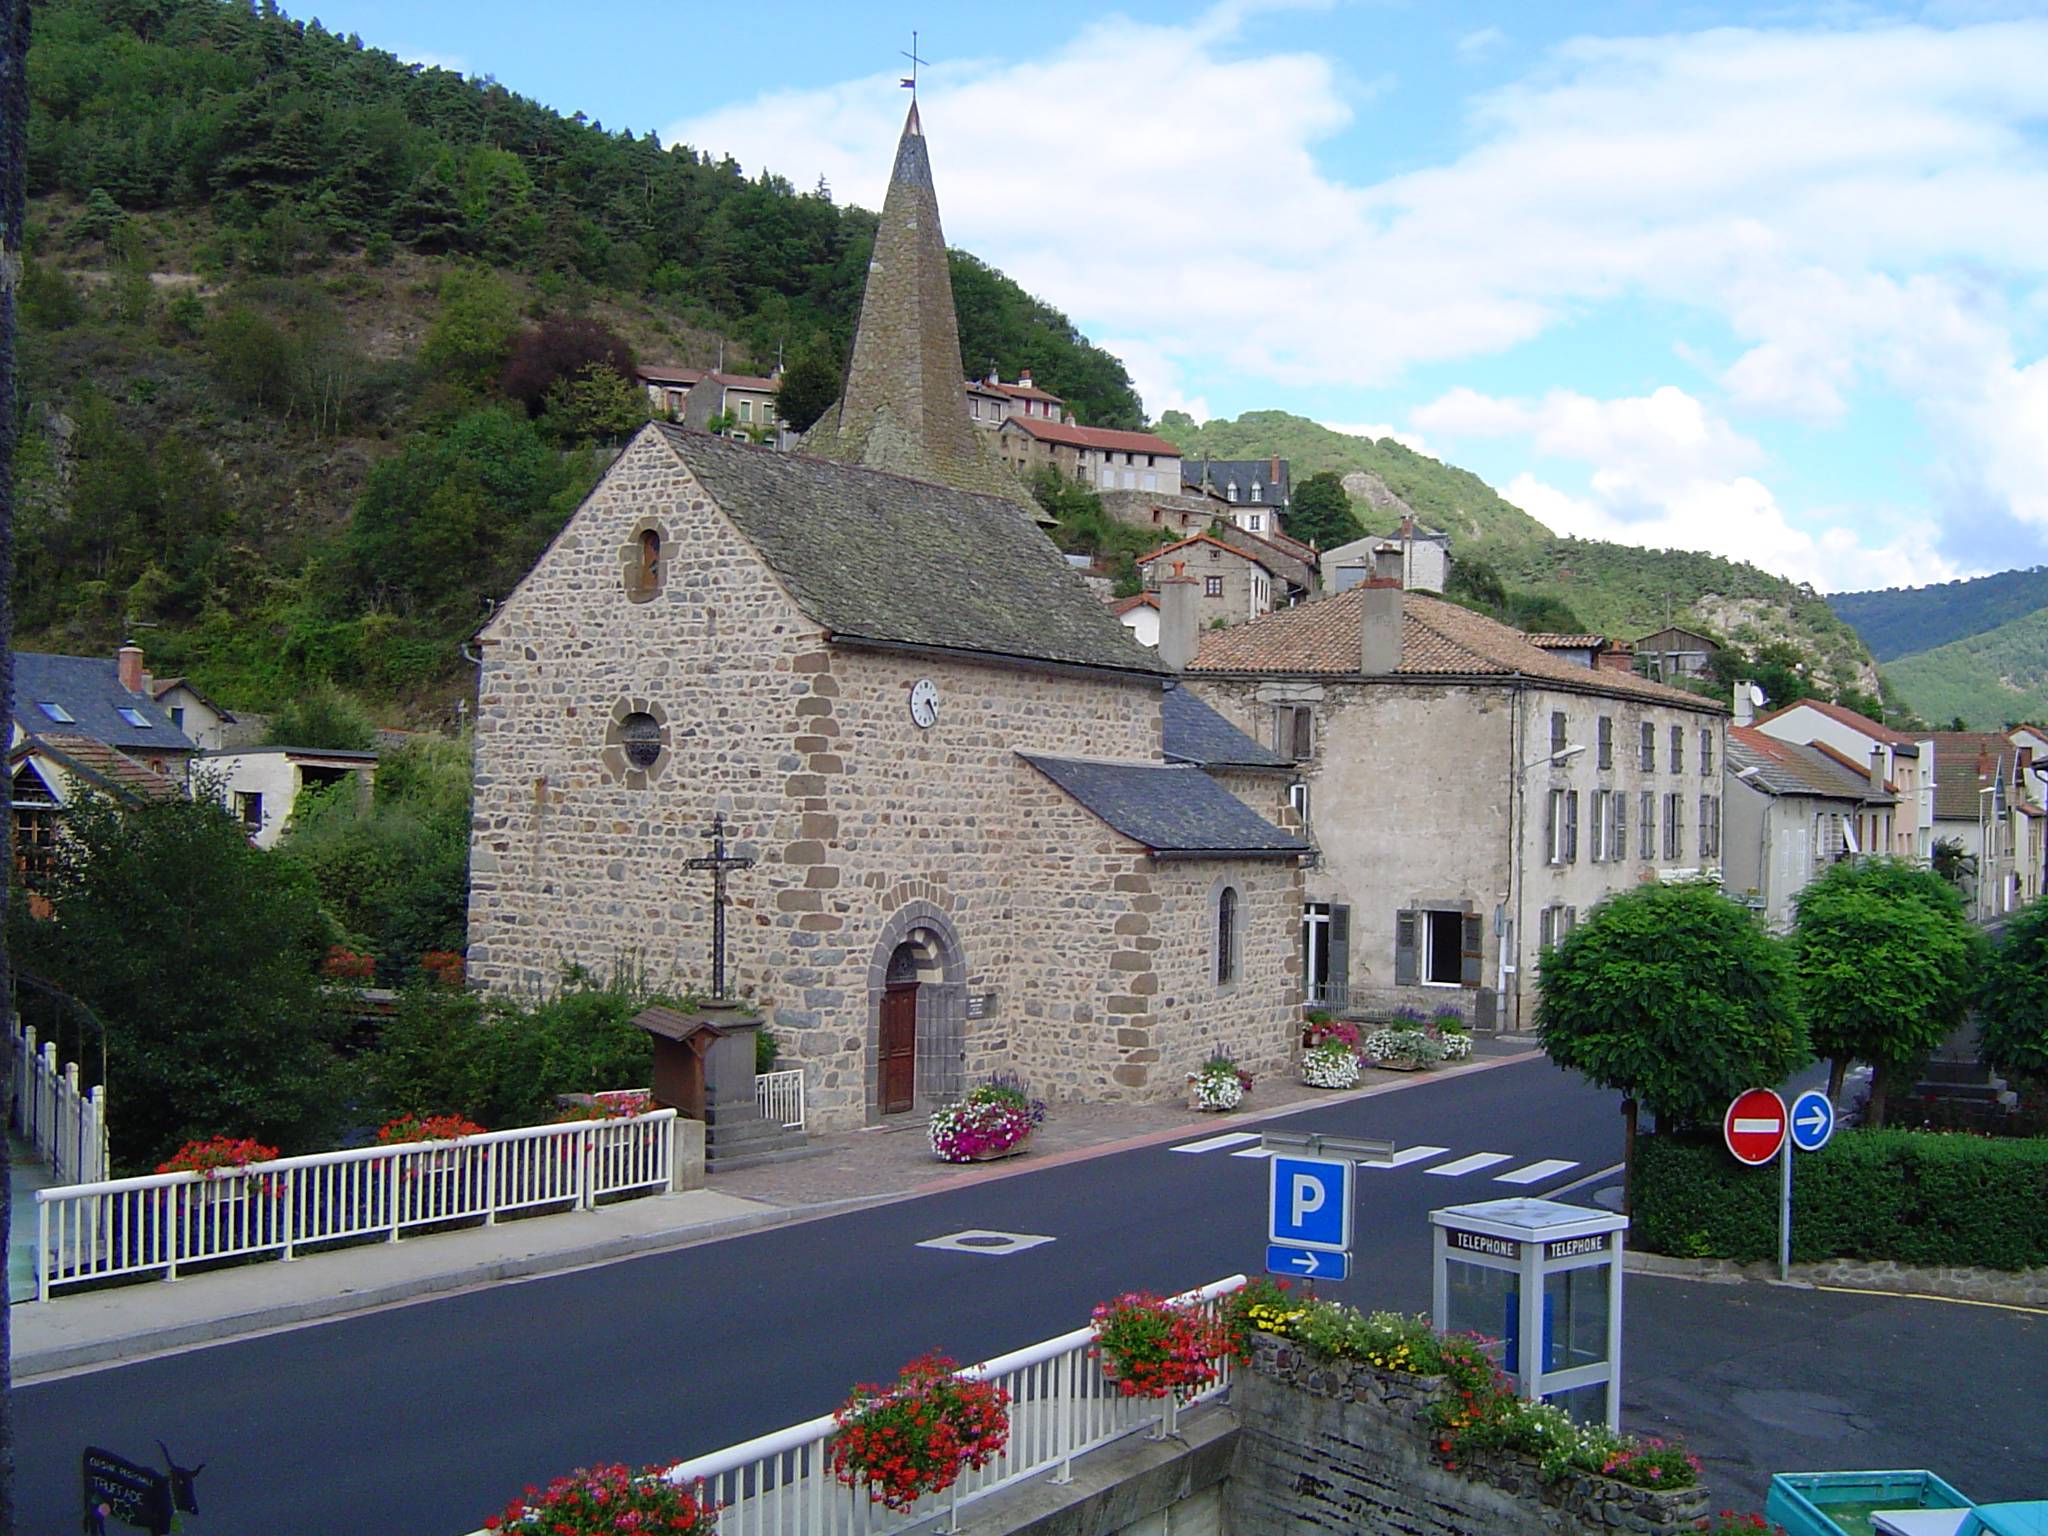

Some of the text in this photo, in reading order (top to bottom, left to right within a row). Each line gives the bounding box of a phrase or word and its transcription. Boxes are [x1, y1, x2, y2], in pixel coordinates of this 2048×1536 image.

[1292, 1174, 1325, 1227] P
[1457, 1232, 1514, 1257] TELEPHONE
[1551, 1236, 1603, 1257] TELEPHONE
